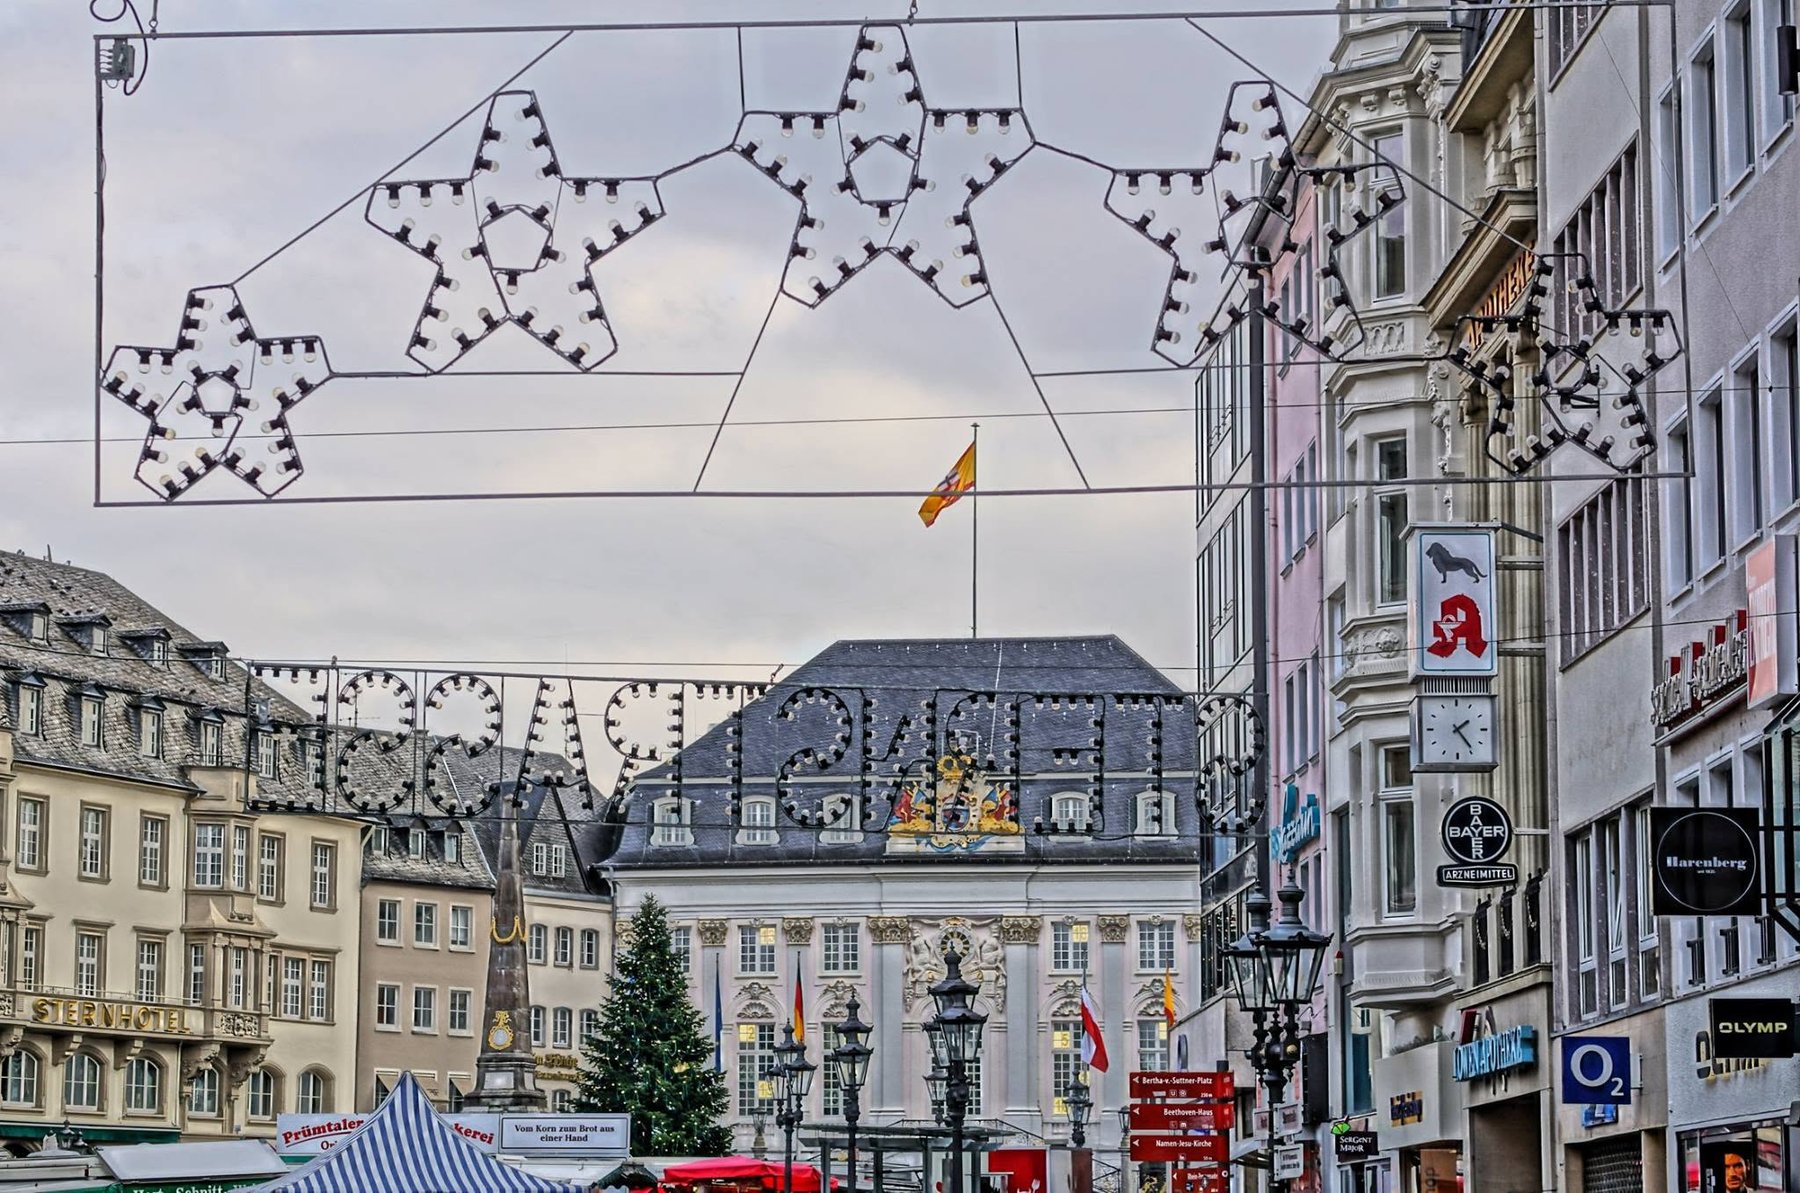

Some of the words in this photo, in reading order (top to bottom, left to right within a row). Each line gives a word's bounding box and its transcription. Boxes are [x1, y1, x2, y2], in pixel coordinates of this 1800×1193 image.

[1449, 825, 1504, 838] BAYER
[1470, 804, 1483, 859] BAYER
[1666, 856, 1747, 871] Harenberg
[1446, 869, 1512, 880] ARZNEIMITTEL
[32, 998, 191, 1034] STERNHOTEL
[1719, 1022, 1787, 1033] OLYMP
[1163, 1108, 1213, 1116] Beethoven-Haus
[282, 1118, 364, 1144] Prümtaler
[515, 1124, 534, 1132] Vom
[536, 1124, 557, 1132] Korn
[579, 1124, 598, 1132] Brot
[540, 1133, 563, 1142] einer
[564, 1133, 589, 1142] Hand
[1155, 1140, 1212, 1148] Namen-Jesu-Kirche
